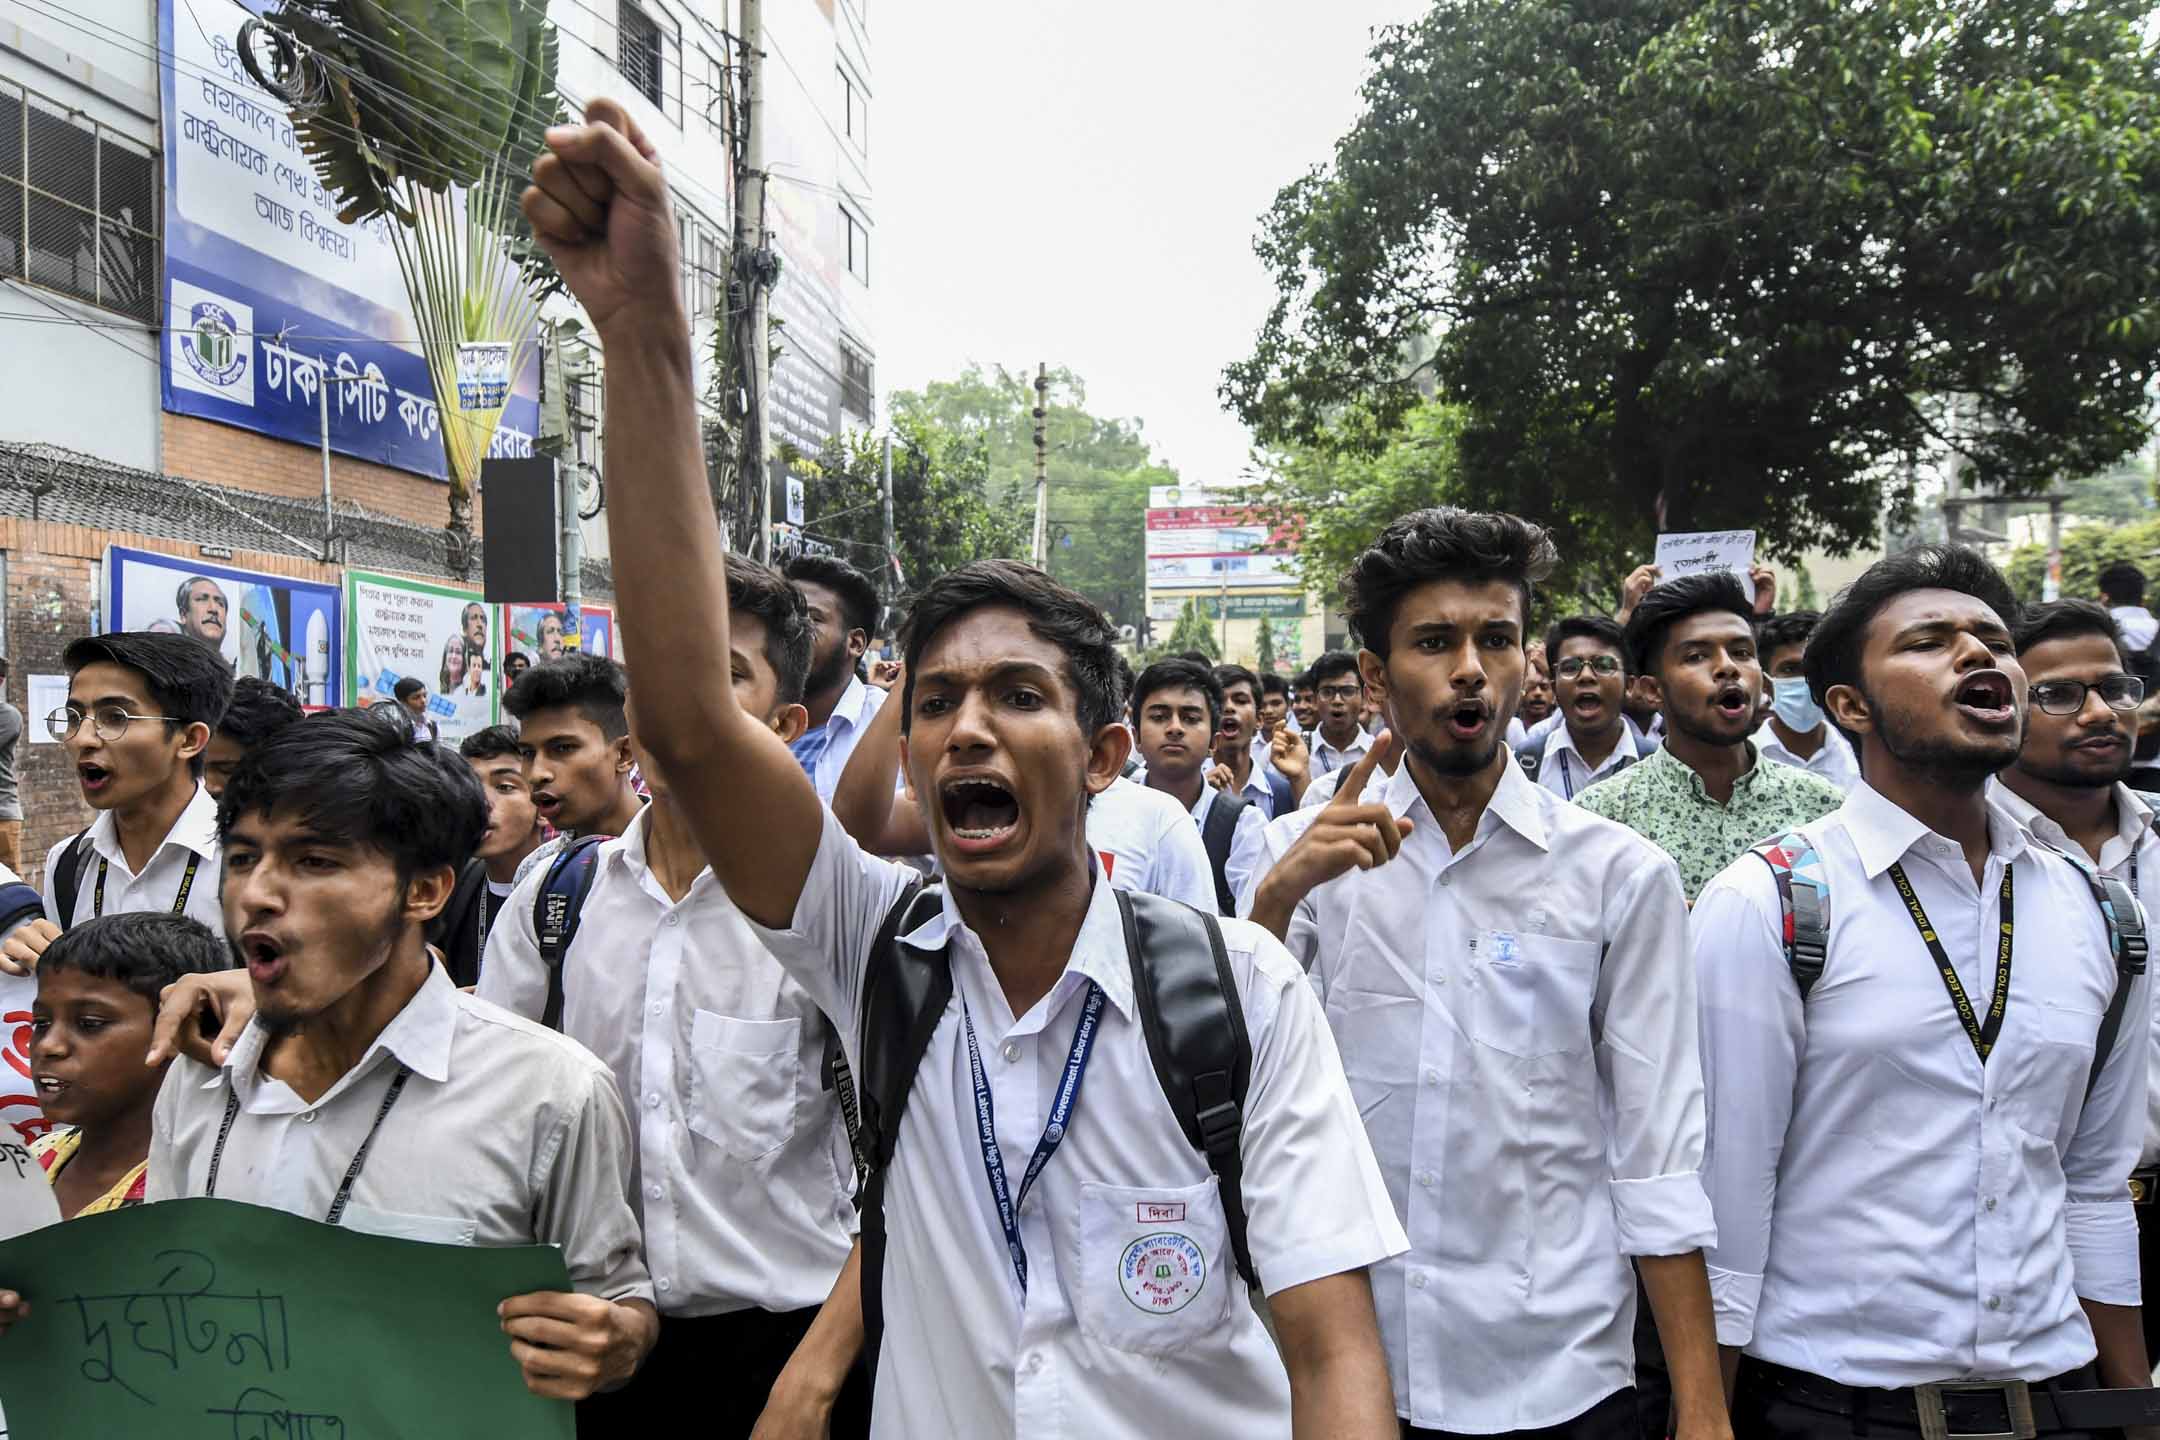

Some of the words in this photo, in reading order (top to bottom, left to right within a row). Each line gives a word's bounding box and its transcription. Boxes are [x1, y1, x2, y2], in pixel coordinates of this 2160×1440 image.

[202, 79, 275, 142] মহাকাশে
[274, 161, 307, 199] শেখ
[254, 192, 295, 233] আজ
[202, 304, 225, 320] DCC
[261, 340, 330, 406] ঢাকা
[332, 352, 390, 425] সিটি
[395, 388, 441, 440] কলে
[1908, 899, 1930, 929] IDEAL
[1999, 936, 2009, 965] IDEAL
[1943, 967, 1972, 1020] COLLEGE
[1991, 968, 2008, 1018] COLLEGE
[1052, 1064, 1080, 1123] Government
[1072, 1015, 1097, 1065] Laboratory
[1085, 993, 1102, 1017] High
[839, 1081, 859, 1142] EDITION
[967, 1032, 984, 1091] Government
[976, 1090, 994, 1144] Laboratory
[986, 1144, 999, 1168] High
[1000, 1203, 1012, 1231] Dhaka
[1148, 1206, 1174, 1220] দিবা
